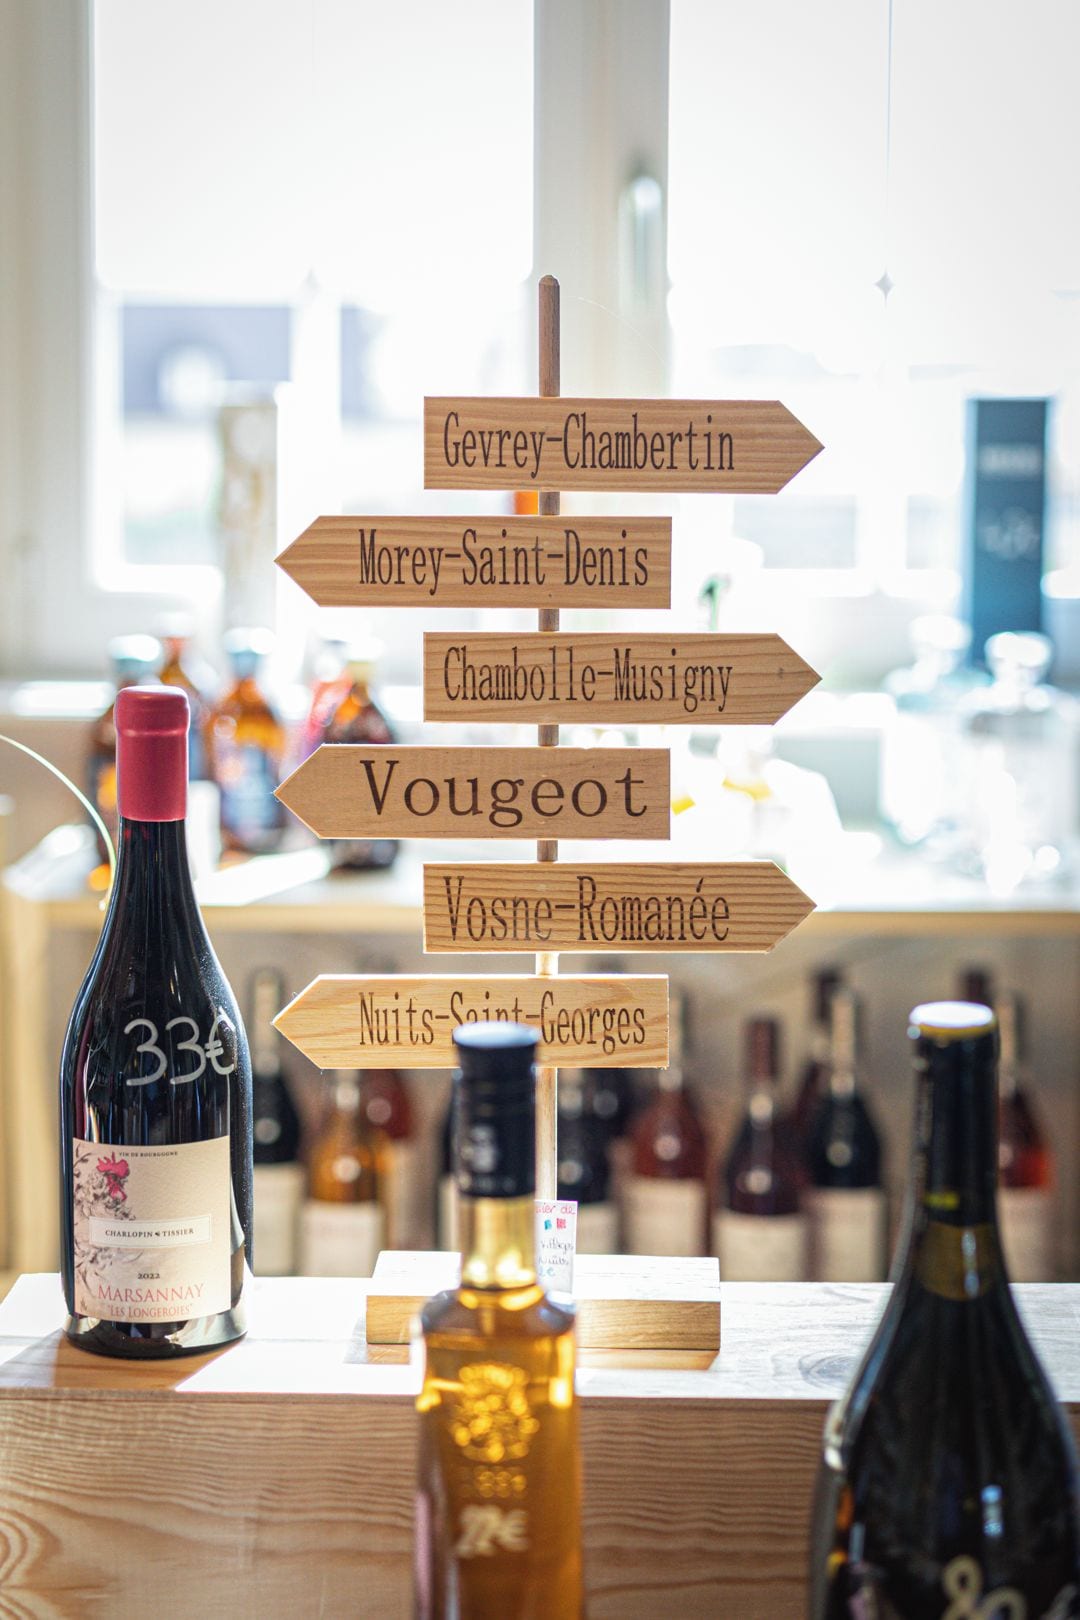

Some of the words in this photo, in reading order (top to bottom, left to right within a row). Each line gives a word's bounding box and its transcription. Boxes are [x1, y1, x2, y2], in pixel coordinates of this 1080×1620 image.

[444, 412, 735, 478] Gevrey-Chambertin
[359, 528, 649, 595] Morey-Saint-Denis
[444, 646, 733, 712] Chambolle-Musigny
[360, 760, 648, 827] Vougeot
[443, 875, 731, 942] Vosne-Romanée
[124, 1013, 236, 1086] 33€
[105, 1229, 153, 1238] CHARLOPIN
[162, 1228, 194, 1237] TISSIER
[97, 1283, 204, 1303] MARSANNAY
